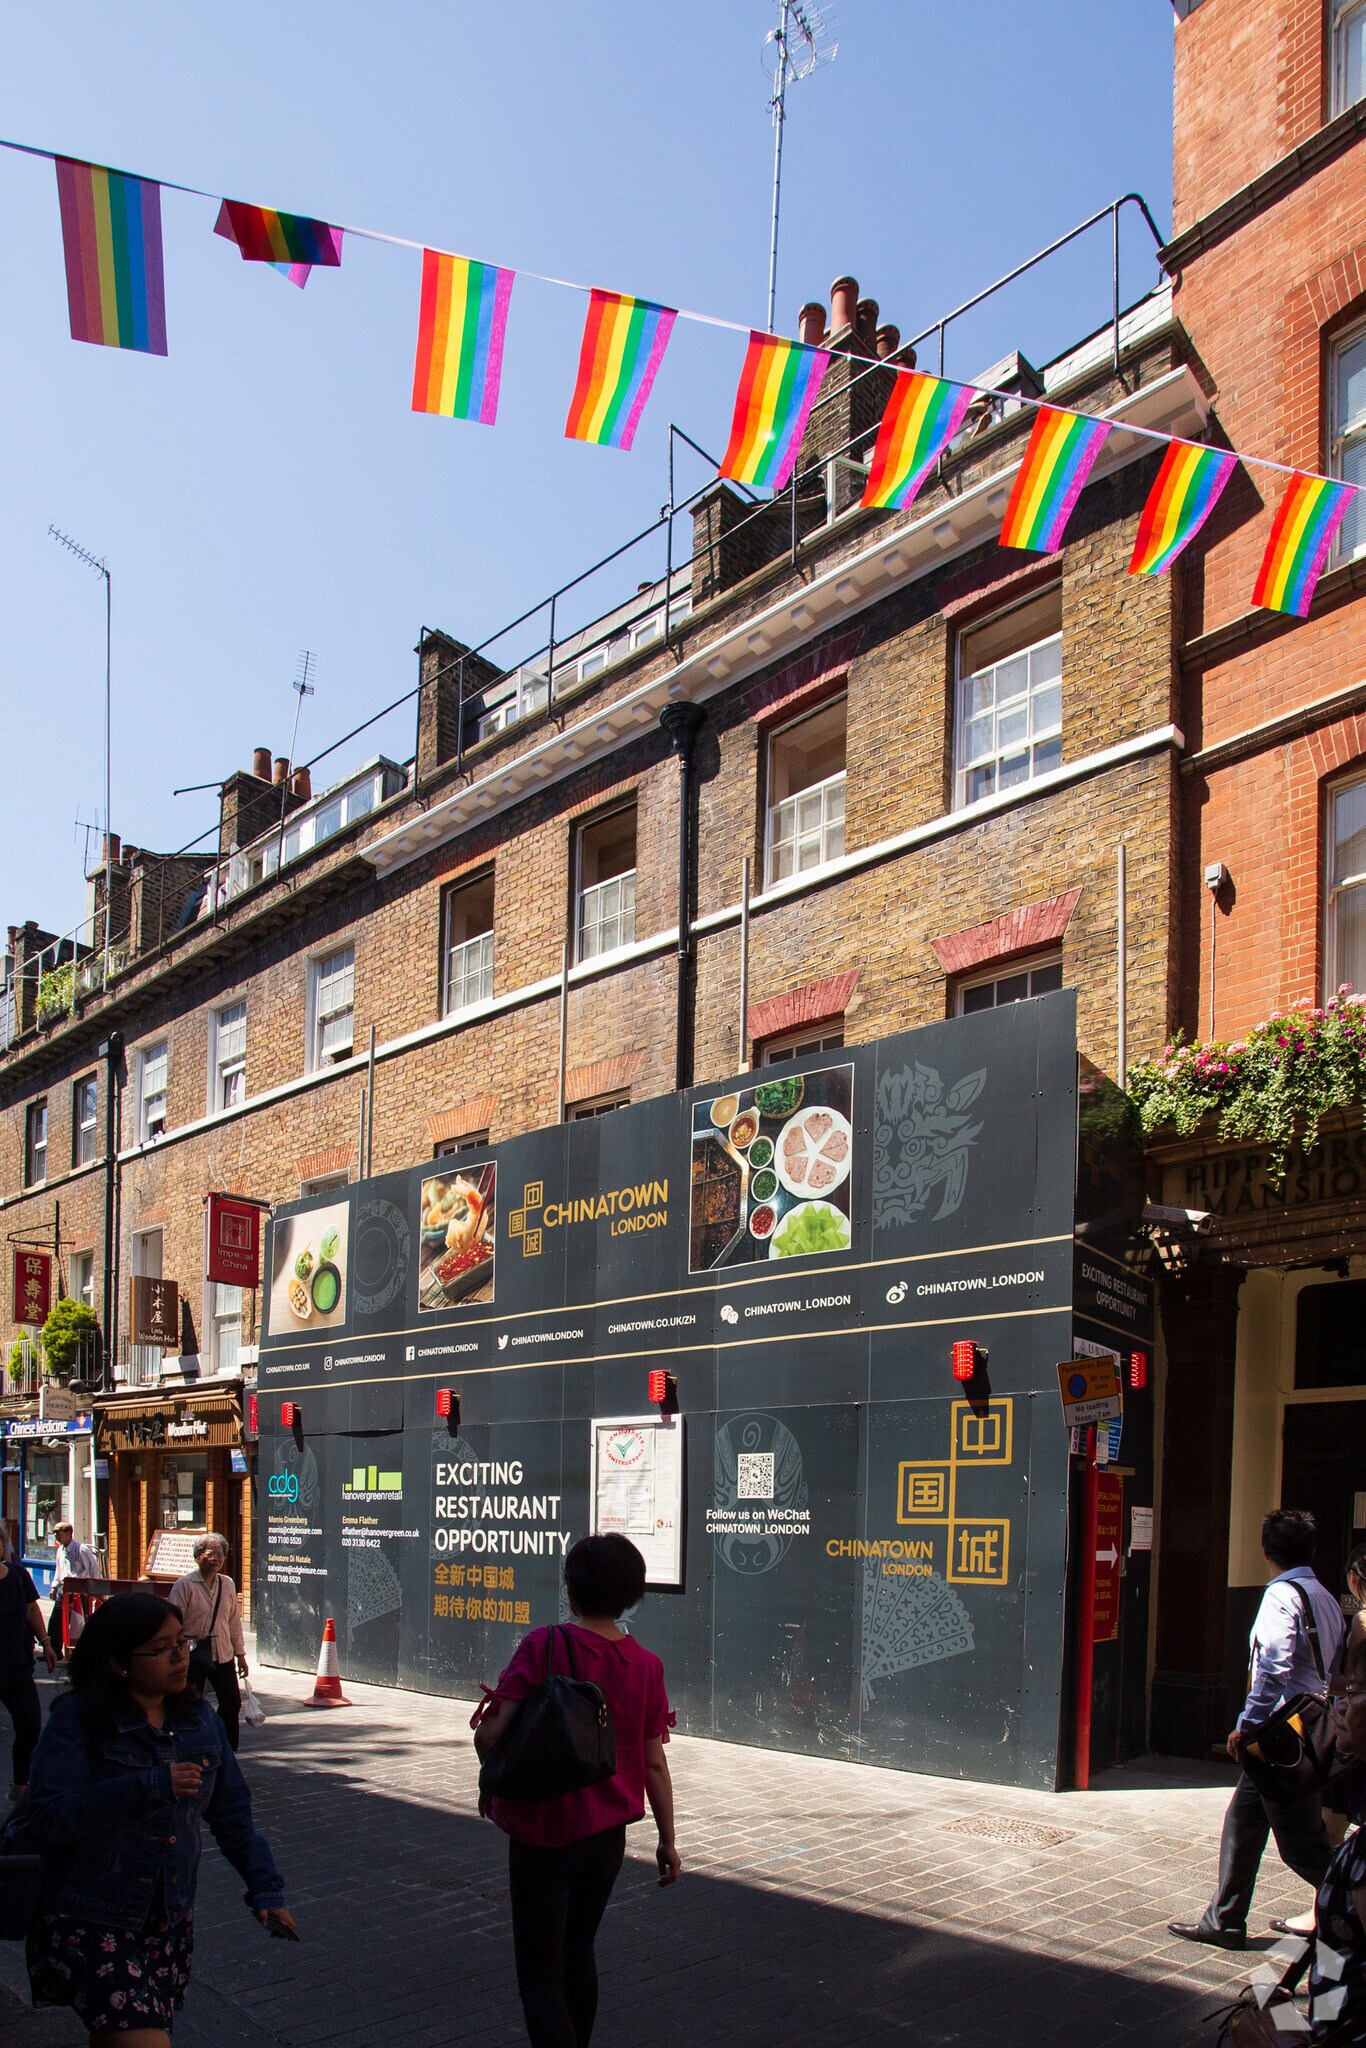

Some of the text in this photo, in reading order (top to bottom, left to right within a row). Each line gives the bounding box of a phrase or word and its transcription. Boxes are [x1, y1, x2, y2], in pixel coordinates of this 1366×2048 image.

[543, 1178, 668, 1227] CHINATOWN
[610, 1210, 668, 1237] LONDON
[222, 1259, 248, 1270] China
[24, 1257, 42, 1320] 保壽堂
[916, 1270, 1044, 1296] CHINATOWN_LONDON
[1082, 1262, 1148, 1307] EXCITING RESTAURANT
[150, 1284, 164, 1324] 小木屋
[744, 1294, 851, 1318] CHINATOWN_LONDON
[1096, 1290, 1136, 1320] OPPORTUNITY
[608, 1314, 696, 1334] CHINATOWN.CO.UK/ZH
[139, 1332, 163, 1341] Wooden
[511, 1330, 584, 1346] CHINATOWNLONDON
[418, 1343, 478, 1357] CHINATOWNLONDON
[334, 1354, 386, 1366] CHINATOWNLONDON
[266, 1363, 310, 1374] CHINATOWN.CO.UK
[1062, 1363, 1096, 1372] Pedestrian
[1086, 1402, 1108, 1410] loading
[10, 1422, 35, 1435] Chinese
[36, 1420, 67, 1434] Medicine
[168, 1422, 193, 1436] Wooden
[436, 1461, 523, 1486] EXCITING
[268, 1468, 299, 1503] cdg
[342, 1483, 402, 1502] hanovergreenretail
[436, 1496, 561, 1520] RESTAURANT
[706, 1509, 810, 1520] Follow us on WeChat
[1097, 1504, 1117, 1513] ESTAURANT
[284, 1516, 308, 1525] Greenberg
[342, 1516, 378, 1524] Emma Flather
[268, 1526, 322, 1536] morris@cdgleisure.com
[342, 1527, 420, 1538] eflather@hanovergreen.co.uk
[706, 1524, 809, 1535] CHINATOWN_LONDON
[268, 1536, 277, 1544] 020
[342, 1538, 380, 1548] 020 3130 6422
[434, 1528, 571, 1556] OPPORTUNITY
[826, 1539, 933, 1559] CHINATOWN
[268, 1554, 289, 1563] Salvatore
[296, 1555, 311, 1563] Natale
[268, 1565, 327, 1576] salvatore@cdgleisure.com
[434, 1562, 515, 1590] 全新中国城
[882, 1563, 933, 1577] LONDON
[434, 1594, 530, 1625] 期待你的加盟
